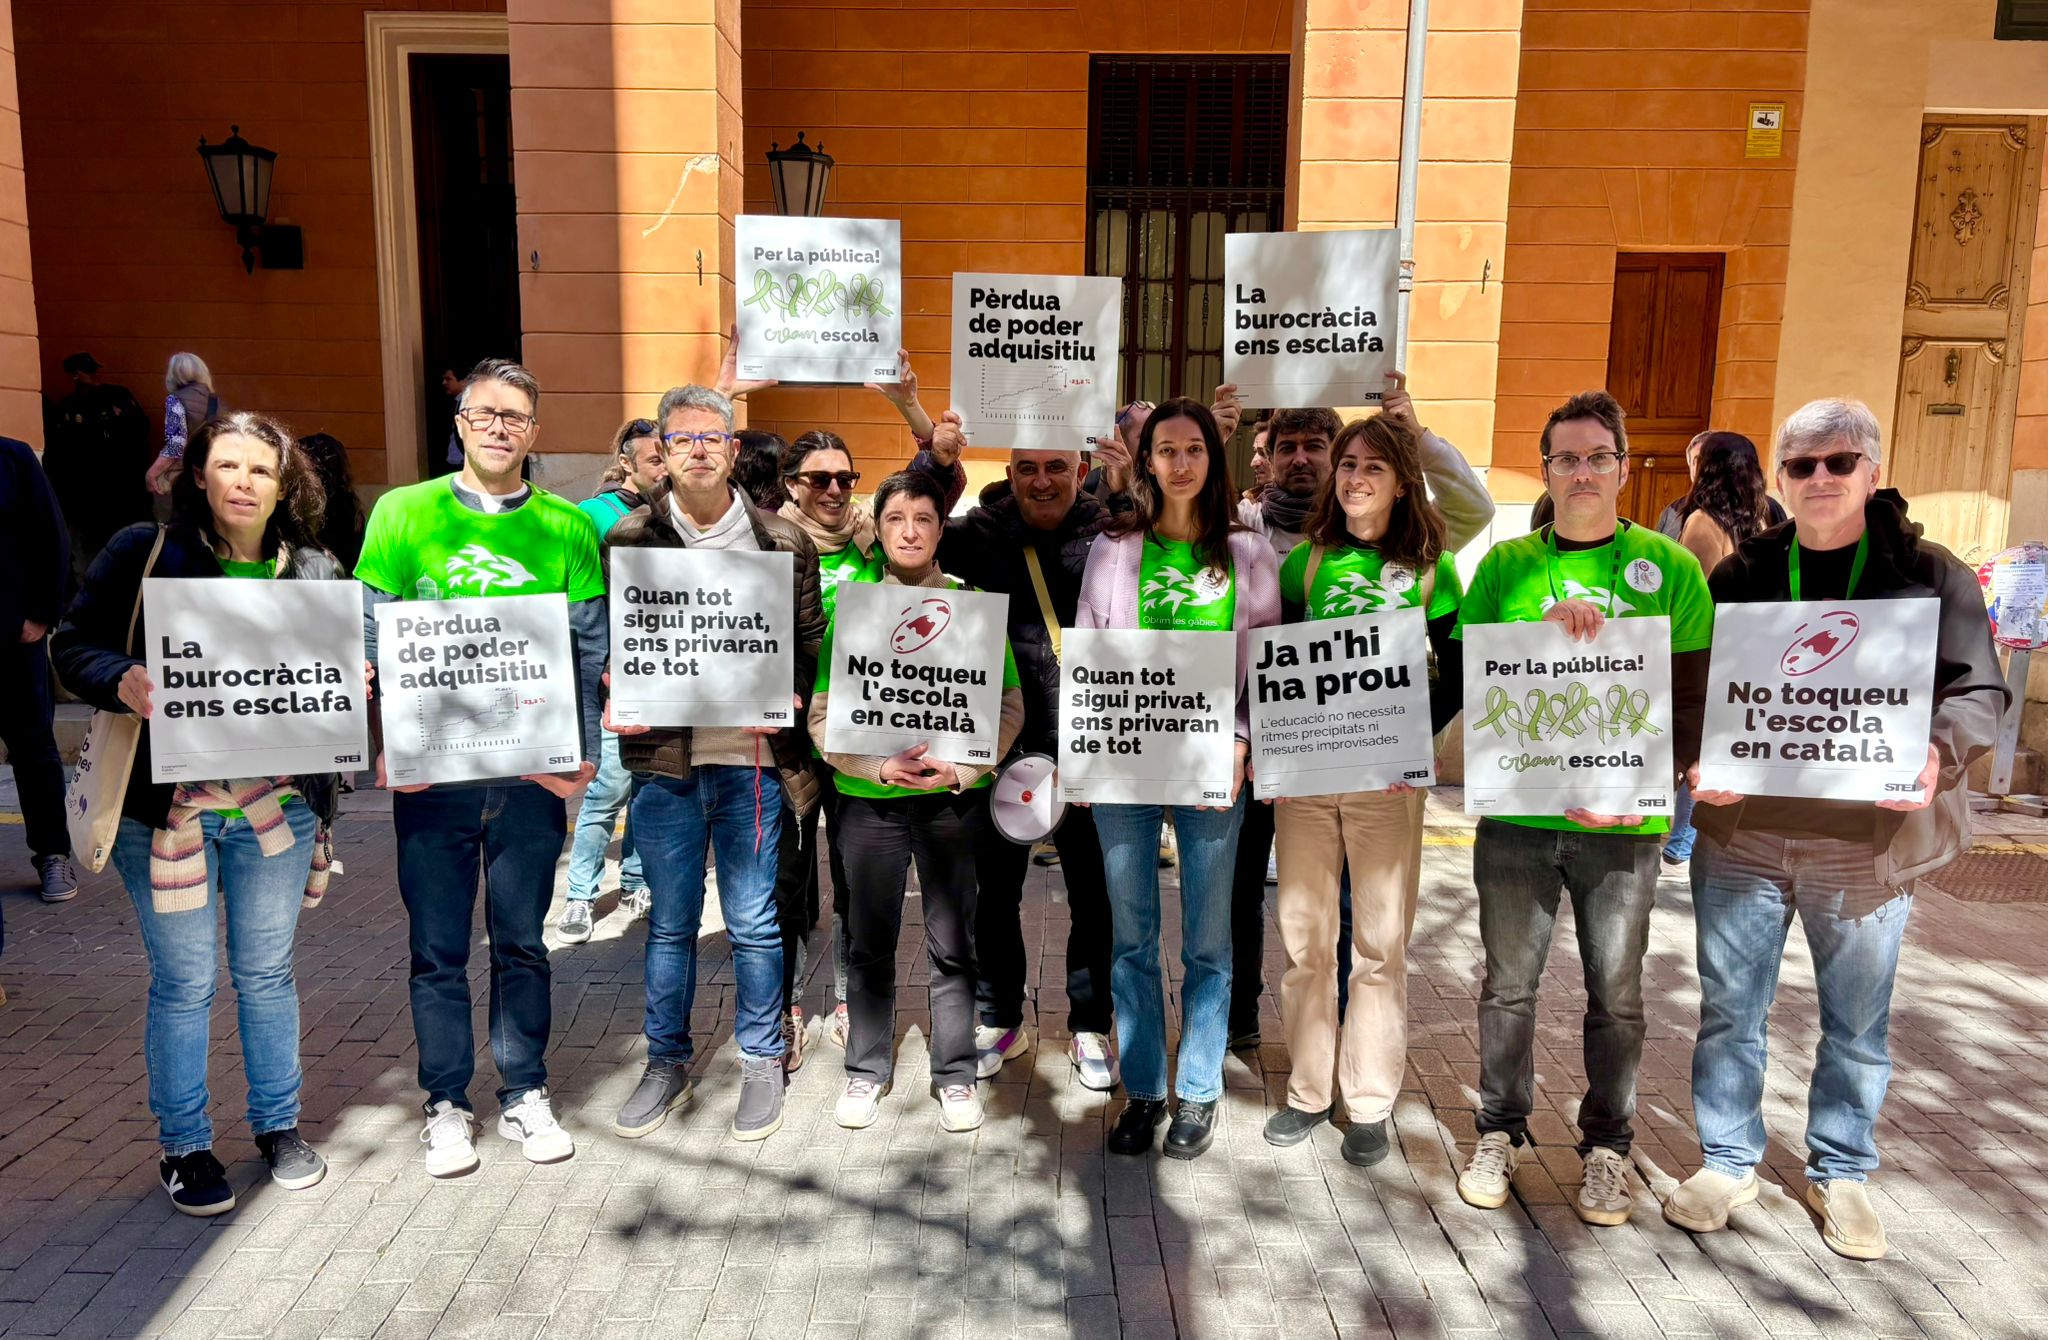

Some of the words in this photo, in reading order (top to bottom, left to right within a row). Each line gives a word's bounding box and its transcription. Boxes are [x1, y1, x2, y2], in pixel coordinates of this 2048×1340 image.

[754, 247, 783, 261] Per
[787, 248, 804, 261] la
[808, 249, 880, 265] pública!
[970, 288, 1060, 310] Pèrdua
[1236, 284, 1266, 304] La
[969, 313, 1001, 333] de
[1007, 315, 1083, 339] poder
[1235, 306, 1377, 330] burocràcia
[821, 329, 879, 342] escola
[1235, 339, 1280, 355] ens
[1286, 332, 1384, 353] esclafa
[968, 338, 1095, 363] adquisitiu
[1365, 392, 1383, 400] STE
[624, 586, 689, 605] Quan
[696, 588, 732, 606] tot
[397, 614, 501, 638] Pèrdua
[624, 609, 684, 633] sigui
[691, 611, 770, 634] privat,
[1143, 616, 1170, 624] Obrim
[1173, 617, 1186, 625] les
[162, 636, 202, 658] La
[398, 642, 436, 663] de
[443, 637, 529, 666] poder
[624, 637, 668, 652] ens
[675, 634, 778, 657] privaran
[1256, 640, 1299, 670] Ja
[1309, 626, 1380, 663] n'hi
[163, 662, 342, 689] burocràcia
[399, 660, 547, 689] adquisitiu
[623, 657, 656, 676] de
[662, 658, 700, 676] tot
[848, 655, 884, 677] No
[891, 659, 987, 687] toqueu
[1072, 666, 1134, 685] Quan
[1140, 667, 1175, 686] tot
[1486, 660, 1521, 676] Per
[1526, 658, 1547, 675] la
[1552, 655, 1644, 678] pública!
[862, 680, 968, 708] l'escola
[1258, 674, 1306, 703] ha
[1316, 665, 1410, 705] prou
[1727, 682, 1772, 704] No
[1781, 682, 1908, 711] toqueu
[164, 699, 225, 718] ens
[233, 690, 352, 715] esclafa
[1071, 689, 1128, 711] sigui
[1135, 691, 1212, 713] privat,
[763, 711, 787, 719] STEI
[851, 708, 883, 726] en
[890, 710, 975, 733] català
[1071, 716, 1112, 731] ens
[1119, 713, 1219, 735] privaran
[1261, 711, 1325, 729] L'educació
[1329, 712, 1344, 722] no
[1347, 705, 1406, 720] necessita
[1745, 708, 1883, 733] l'escola
[1261, 729, 1298, 742] ritmes
[1302, 723, 1365, 741] precipitats
[1369, 721, 1379, 732] ni
[968, 749, 991, 758] STEI
[1070, 735, 1101, 753] de
[1107, 736, 1142, 754] tot
[1262, 742, 1313, 757] mesures
[1317, 734, 1399, 753] improvisades
[1730, 740, 1771, 759] en
[1780, 739, 1894, 763] català
[334, 754, 361, 764] STEI
[549, 755, 574, 765] STEI
[1569, 751, 1643, 767] escola
[1403, 770, 1428, 780] STEI
[1203, 791, 1227, 799] STEI
[1884, 783, 1916, 792] STEI
[1638, 799, 1666, 807] STEI
